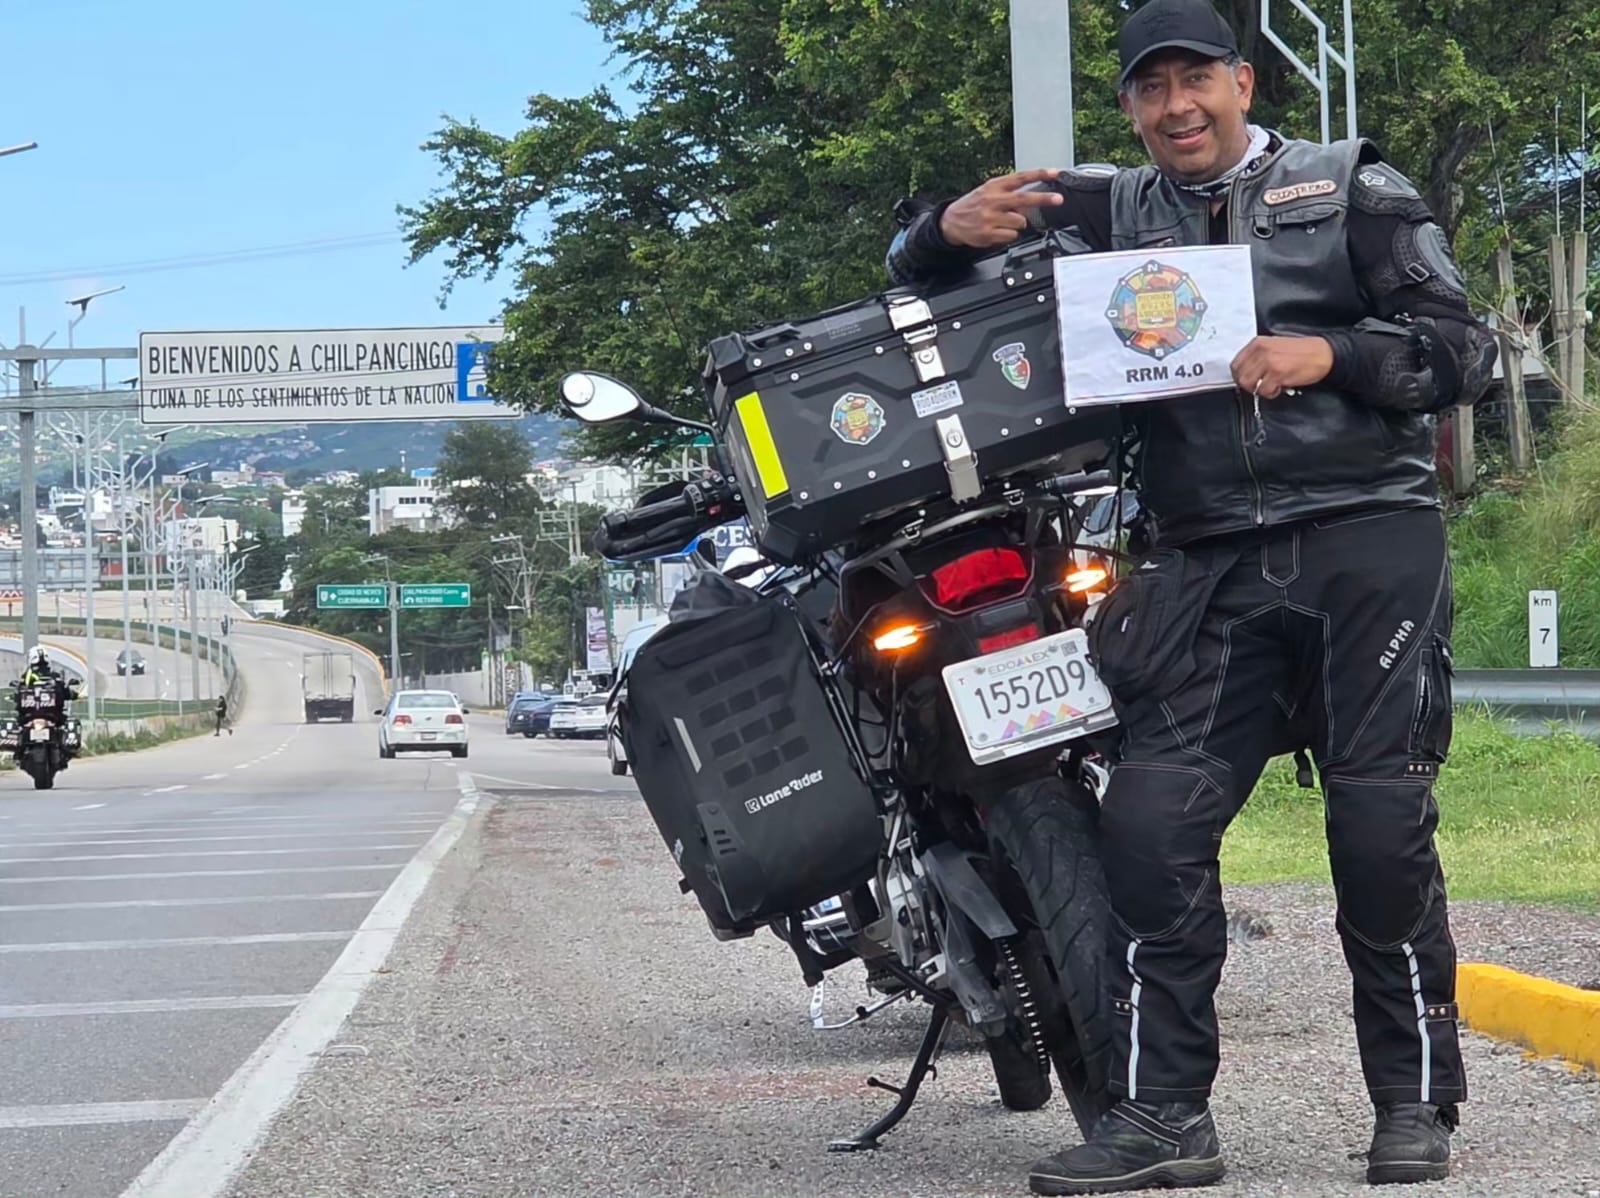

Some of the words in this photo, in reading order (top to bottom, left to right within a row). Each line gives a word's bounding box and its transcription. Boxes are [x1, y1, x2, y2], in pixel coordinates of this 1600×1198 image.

[150, 344, 279, 374] BIENVENIDOS
[289, 344, 302, 372] A
[311, 341, 454, 372] CHILPANCINGO
[1125, 366, 1169, 383] RRM
[1174, 363, 1204, 378] 4.0
[150, 388, 187, 409] CUNA
[194, 388, 211, 408] DE
[218, 387, 244, 408] LOS
[252, 386, 348, 408] SENTIMIENTOS
[355, 386, 372, 406] DE
[380, 385, 397, 405] LA
[1533, 597, 1552, 606] km
[1379, 619, 1415, 669] ALPHA
[1539, 628, 1551, 645] 7
[974, 659, 1086, 720] 1552D9
